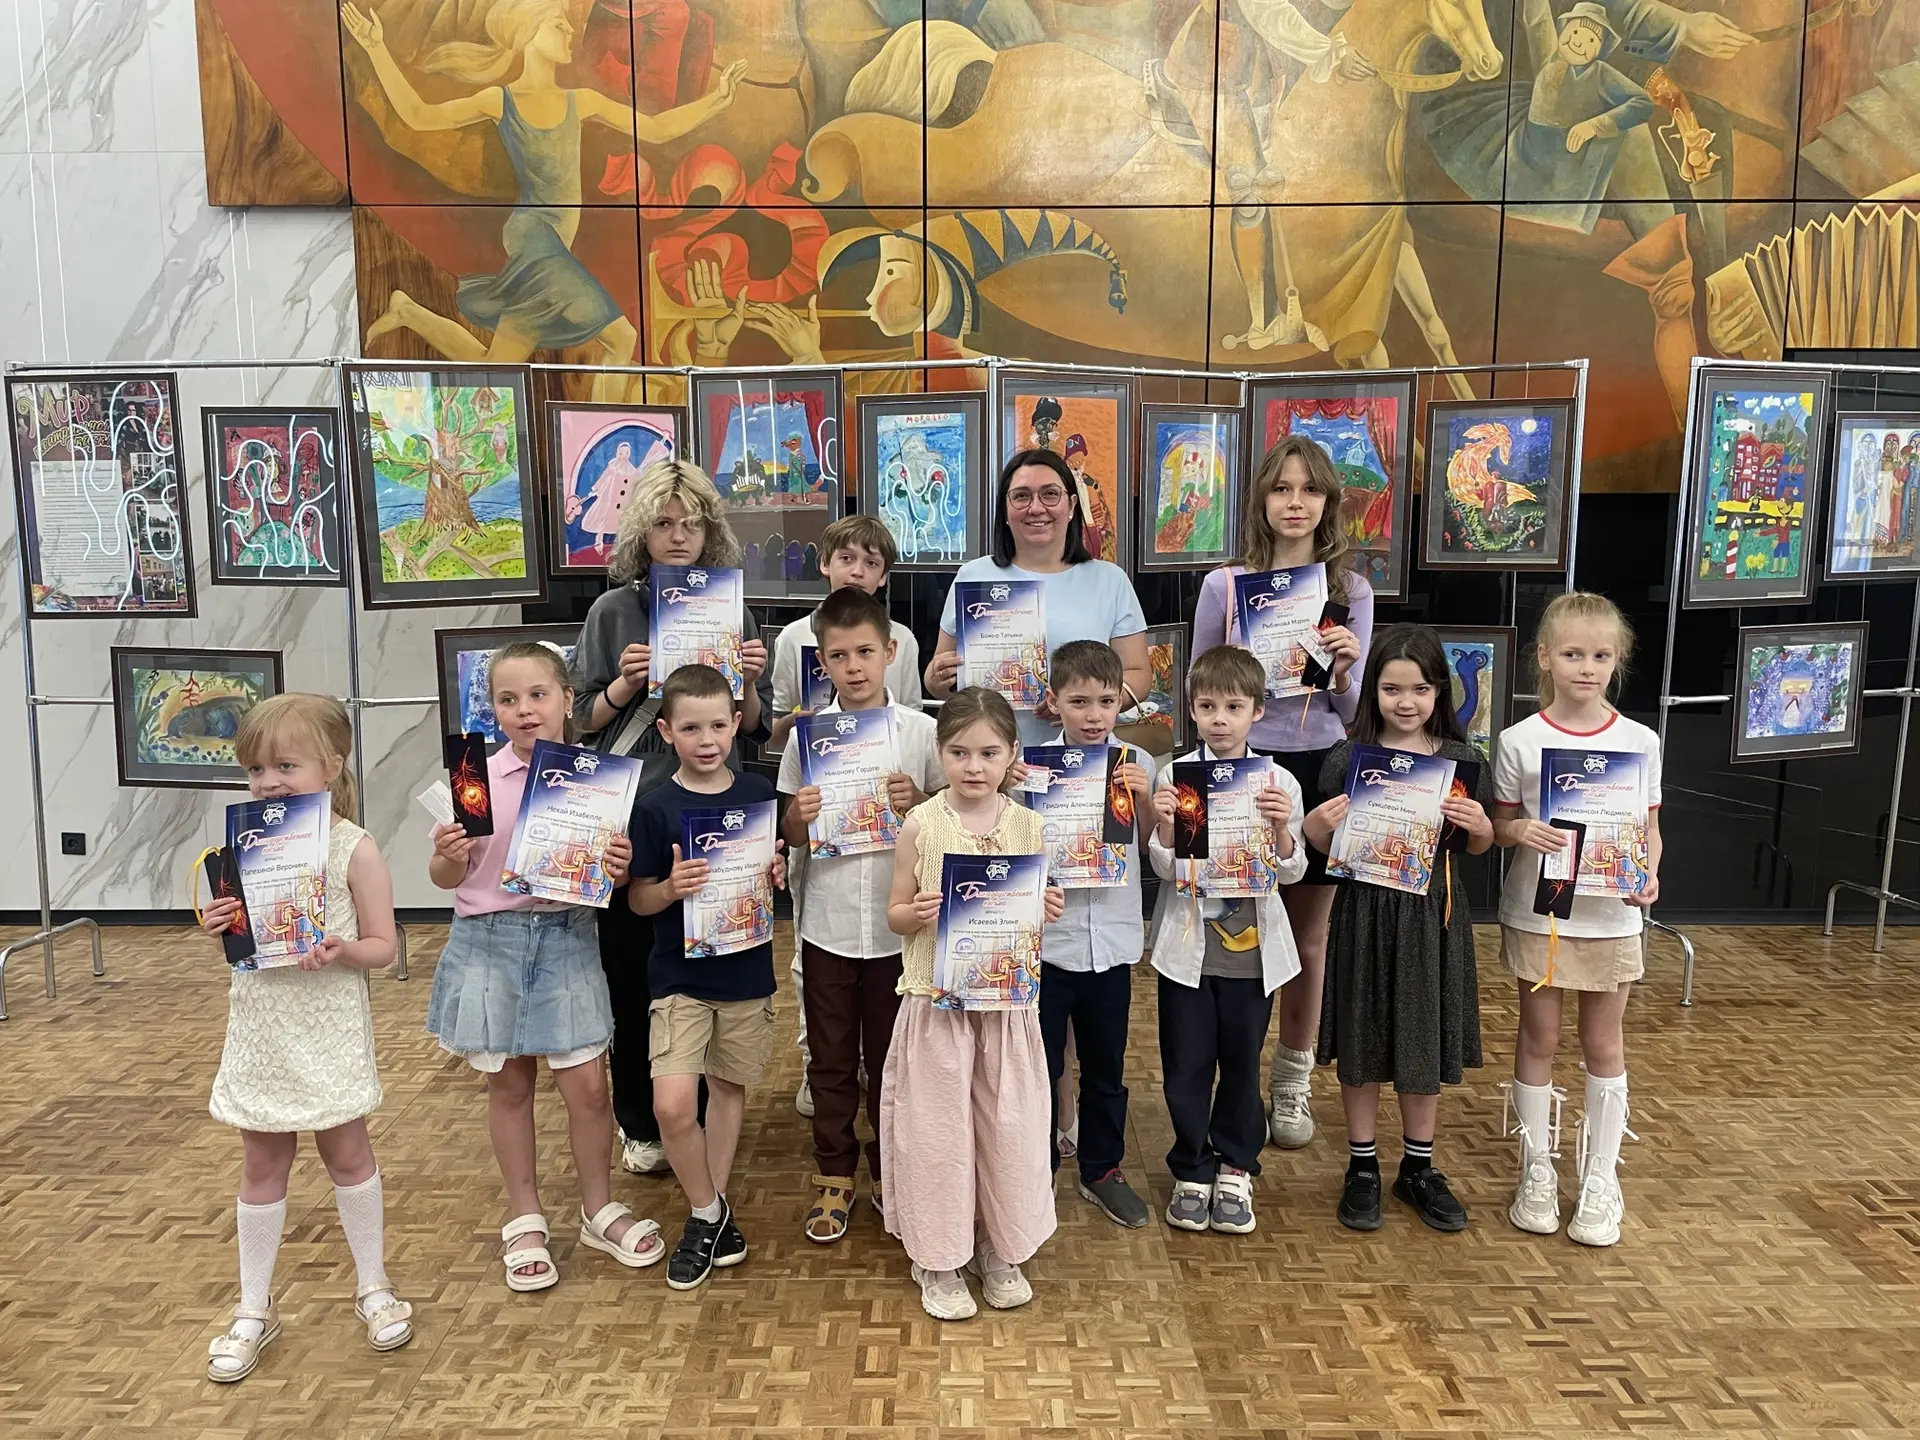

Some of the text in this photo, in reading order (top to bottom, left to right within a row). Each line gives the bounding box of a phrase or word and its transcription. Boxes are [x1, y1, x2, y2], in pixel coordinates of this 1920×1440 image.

[17, 388, 90, 438] Мир
[547, 805, 603, 821] Нехай Изабелле
[276, 862, 309, 872] Веронике
[968, 918, 998, 926] Исаевой
